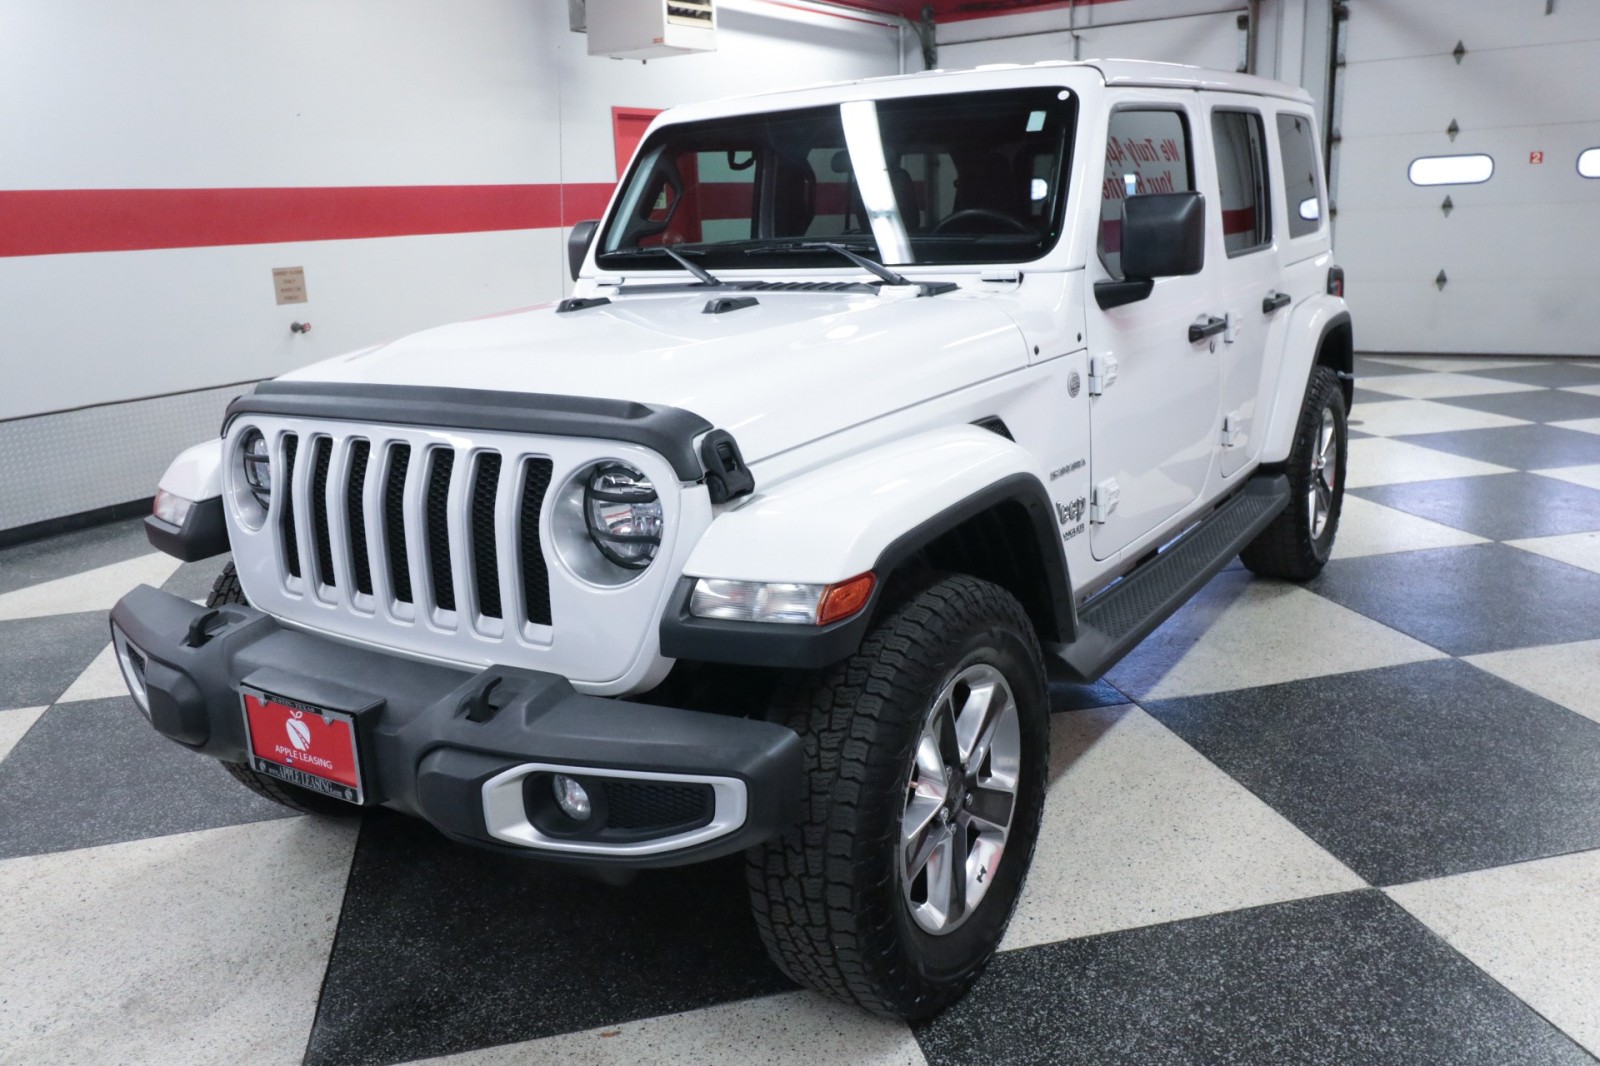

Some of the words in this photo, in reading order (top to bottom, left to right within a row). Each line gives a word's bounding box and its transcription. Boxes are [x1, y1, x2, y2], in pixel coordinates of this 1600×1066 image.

[1532, 152, 1542, 164] 2
[275, 745, 298, 759] APPLE
[299, 752, 333, 769] LEASING
